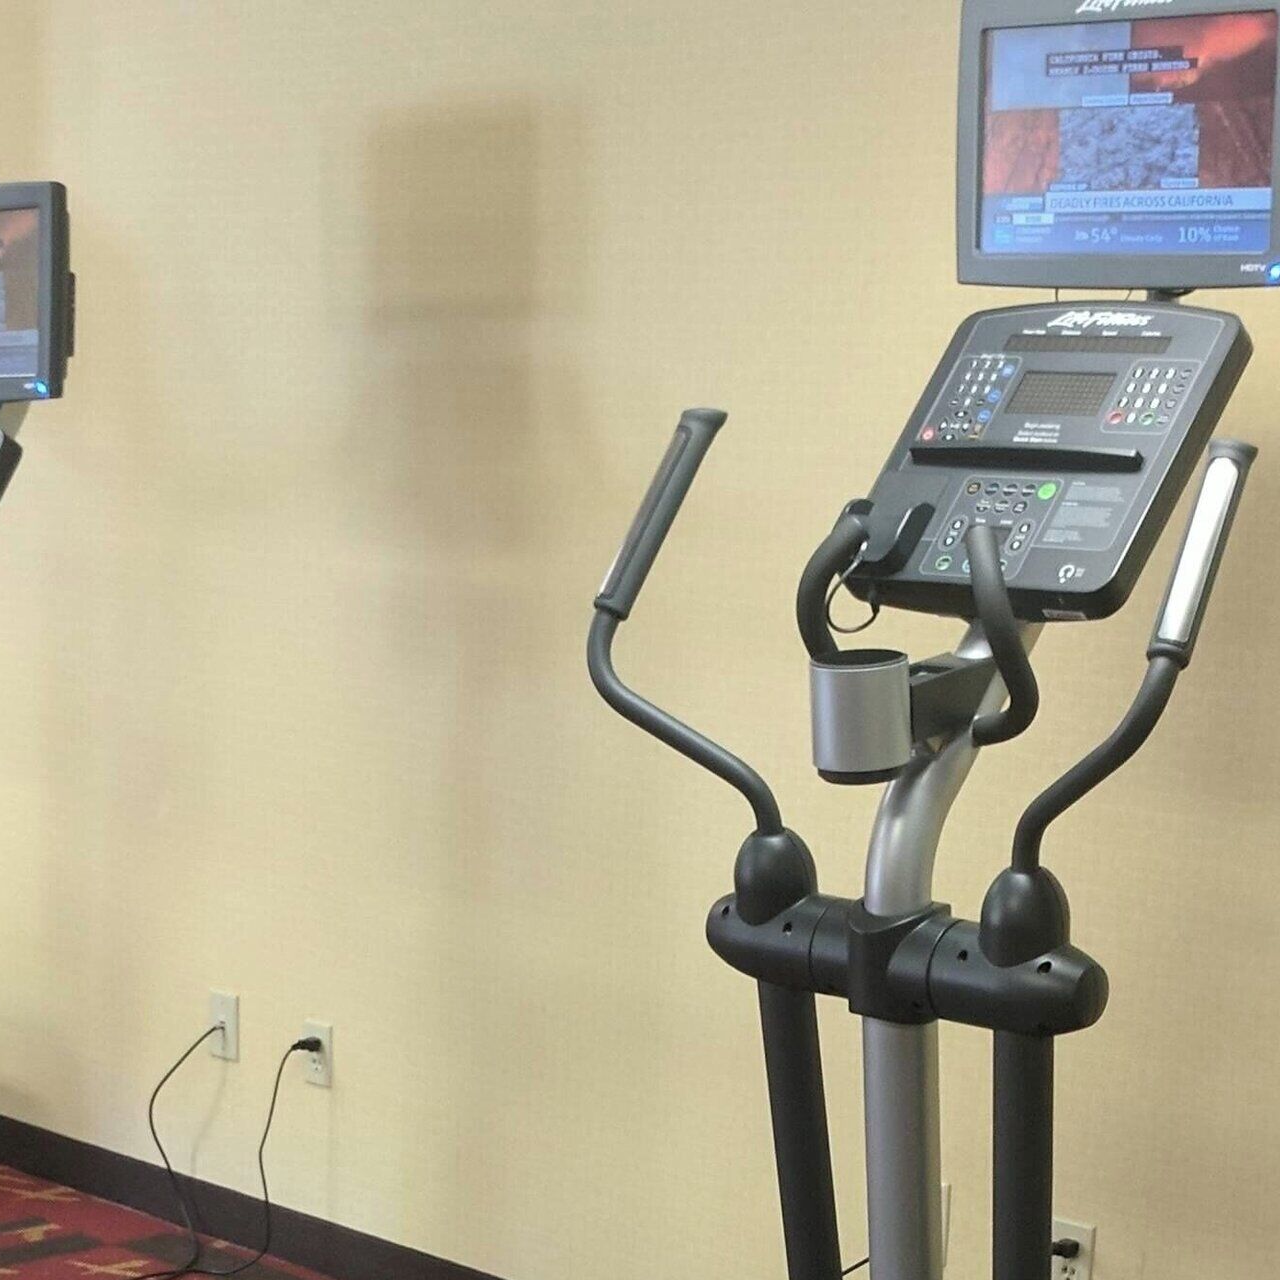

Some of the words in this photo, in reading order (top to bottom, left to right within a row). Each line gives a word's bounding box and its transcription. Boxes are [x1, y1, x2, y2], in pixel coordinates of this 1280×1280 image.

[1122, 195, 1166, 207] ACROSS
[1167, 194, 1234, 206] CALIFORNIA
[1178, 225, 1212, 243] 10%
[1240, 263, 1267, 272] HDTV
